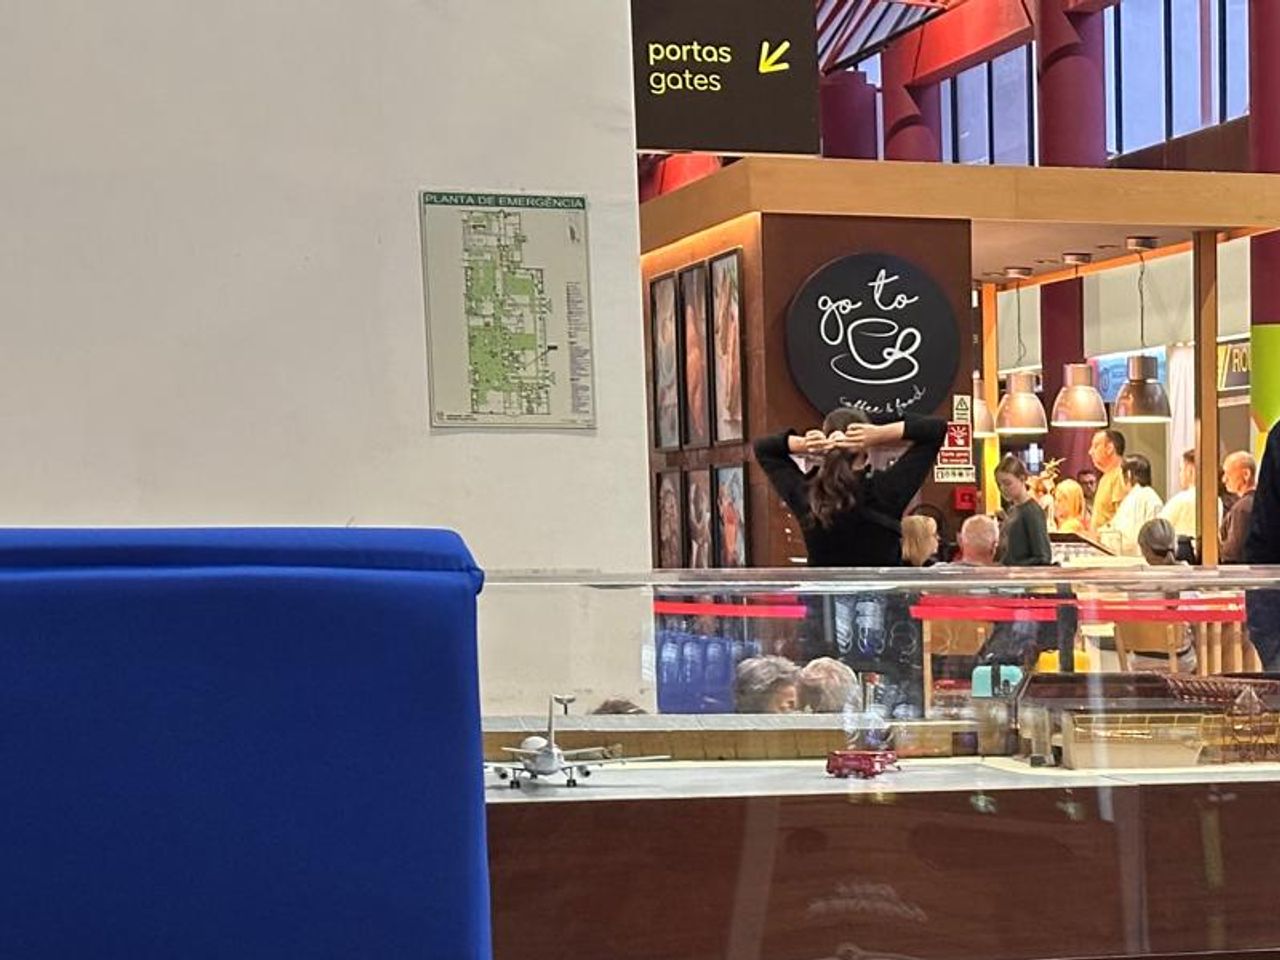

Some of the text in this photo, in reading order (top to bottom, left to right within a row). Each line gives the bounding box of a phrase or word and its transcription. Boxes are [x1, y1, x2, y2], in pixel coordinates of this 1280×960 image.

[648, 41, 732, 65] portas
[650, 69, 721, 95] gates
[425, 194, 584, 208] PLANTA DE EMERGÊNCIA
[817, 268, 920, 346] go to
